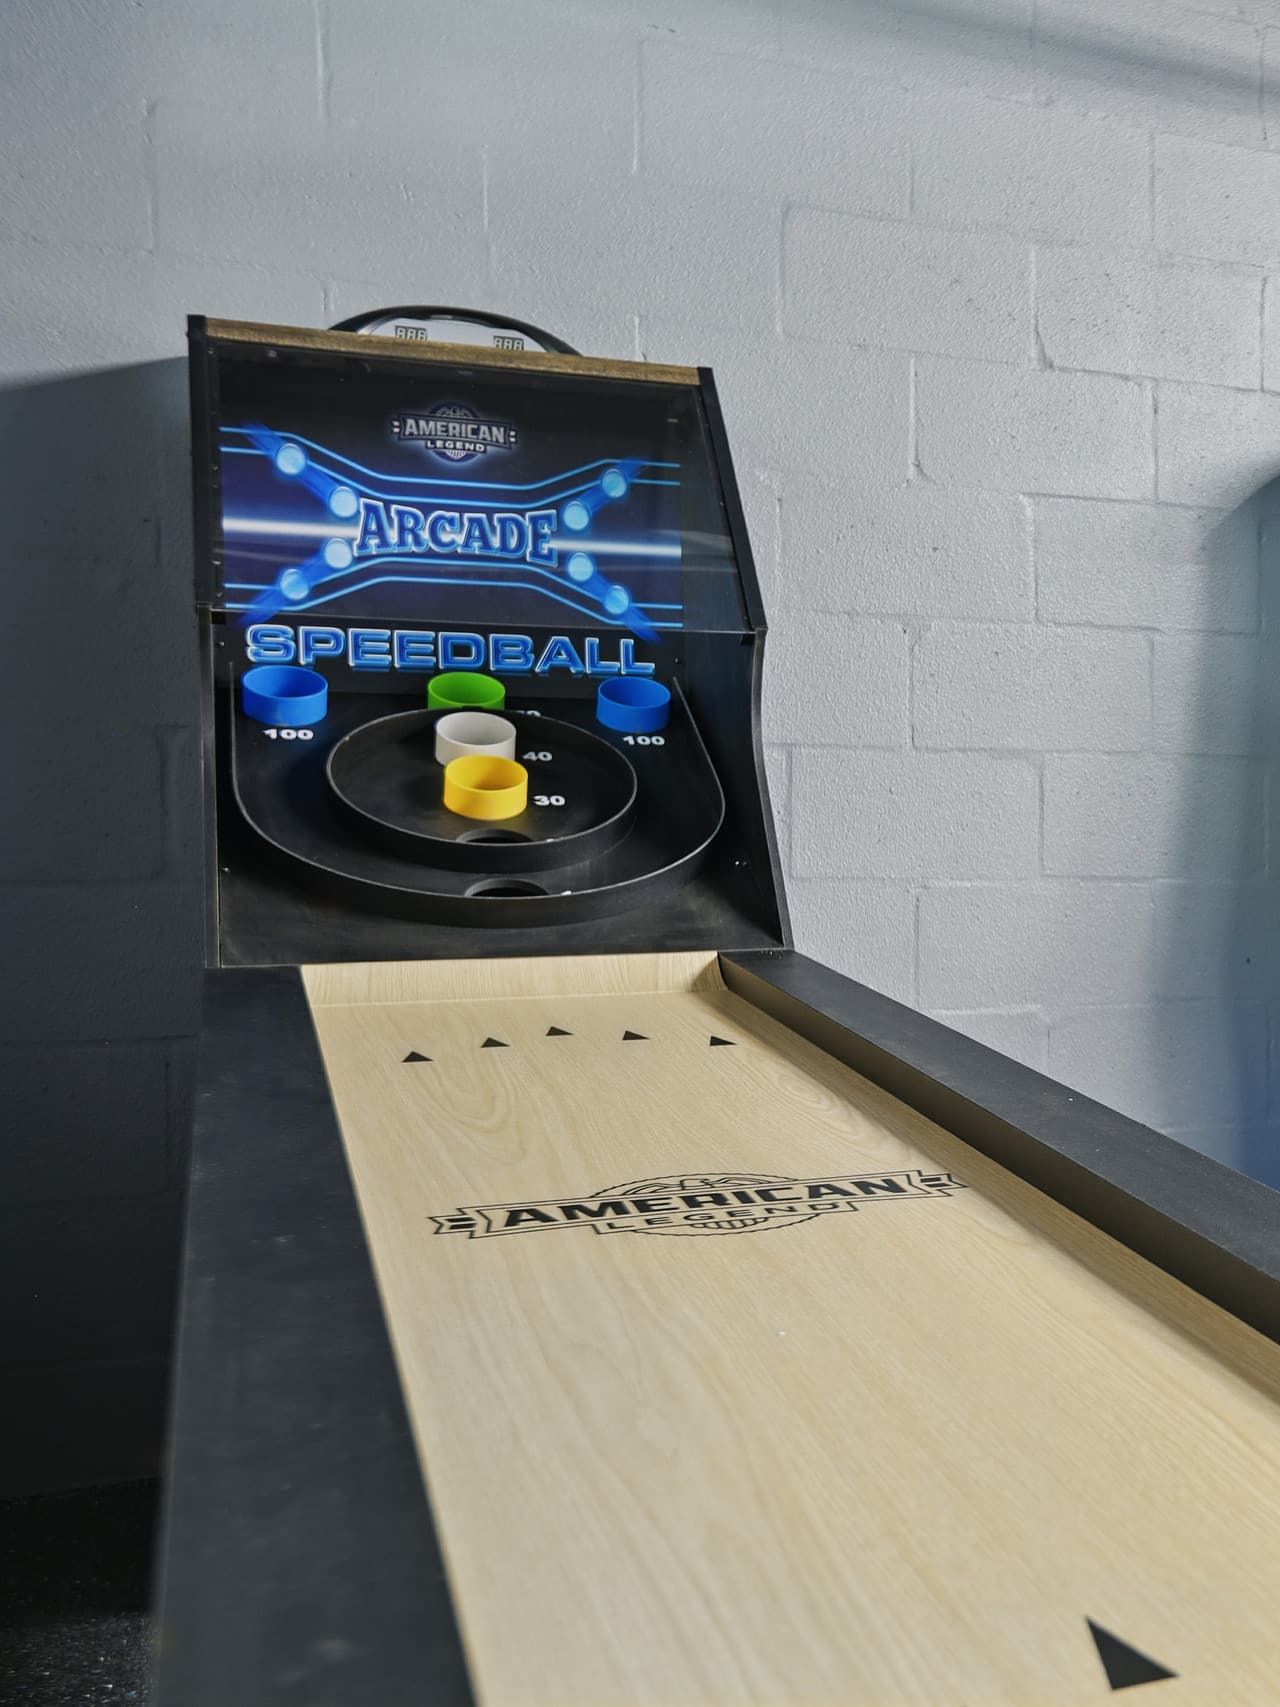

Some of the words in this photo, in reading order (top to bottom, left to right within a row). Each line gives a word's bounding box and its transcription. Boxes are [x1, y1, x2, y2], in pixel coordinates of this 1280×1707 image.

[404, 418, 505, 443] AMERICAN
[426, 439, 485, 452] LEGEND
[354, 497, 558, 567] ARCADE
[246, 623, 656, 676] SPEEDBALL
[263, 728, 314, 741] 100
[623, 735, 666, 746] 100
[522, 751, 553, 762] 40
[533, 795, 566, 806] 30
[504, 1177, 908, 1227] AMERICAN
[606, 1202, 838, 1230] LEGEND
